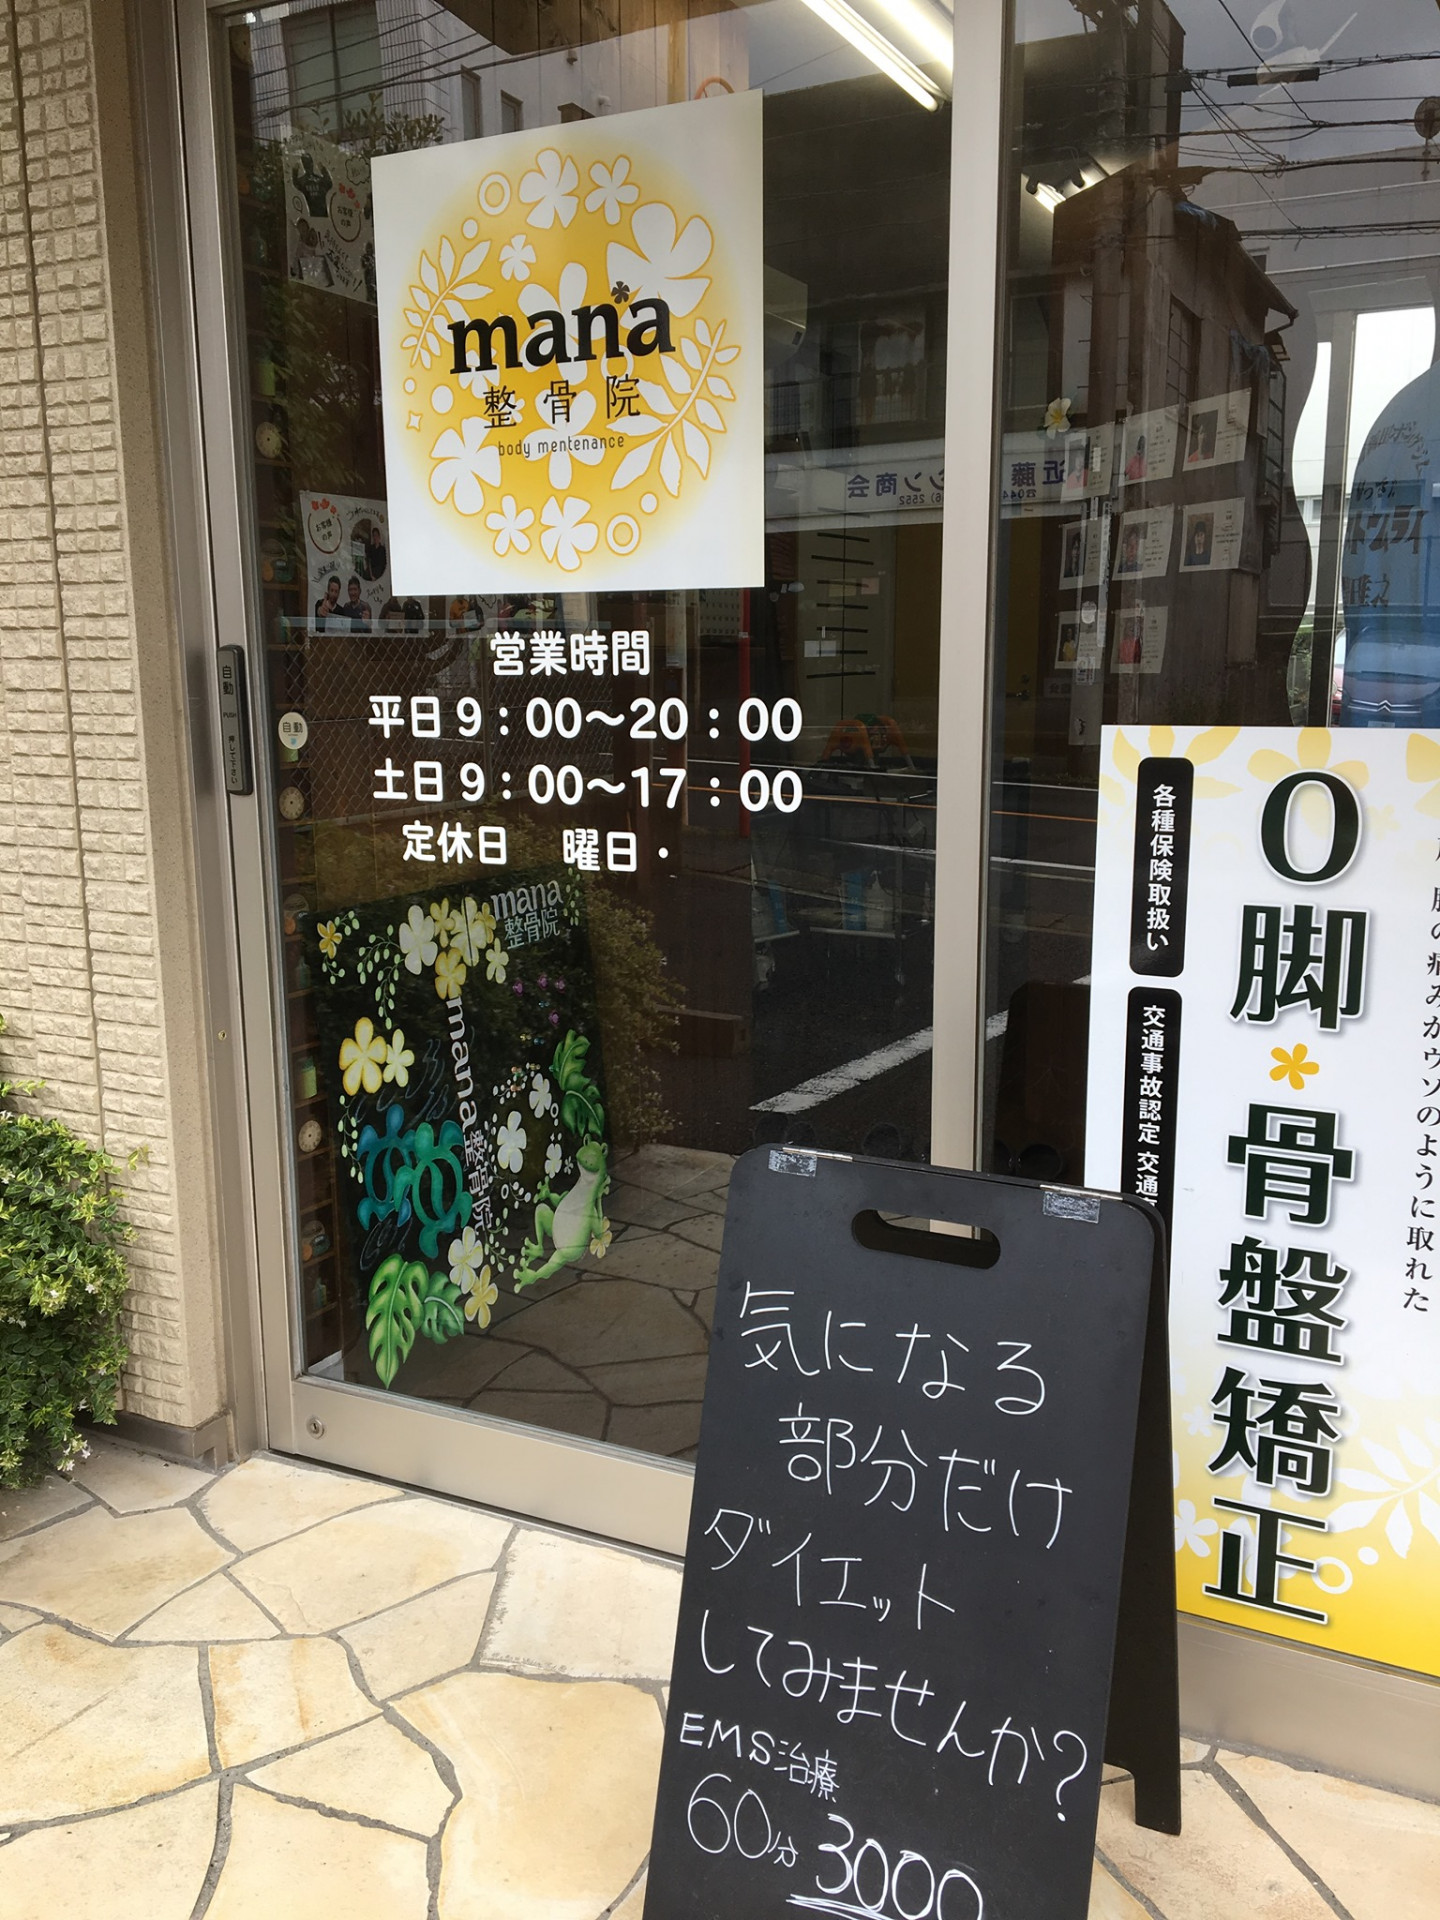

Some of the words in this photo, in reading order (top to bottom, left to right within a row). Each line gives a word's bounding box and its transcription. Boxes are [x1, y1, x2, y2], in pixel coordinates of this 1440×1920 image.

[447, 297, 676, 374] mana
[482, 373, 642, 429] 整骨院
[498, 441, 531, 458] body
[537, 435, 625, 454] mentenance
[222, 664, 234, 695] 自動
[490, 630, 650, 676] 営業時間
[222, 711, 237, 719] PUSH
[282, 721, 304, 733] 自動
[402, 820, 507, 865] 定休日
[1146, 783, 1177, 952] 各種保険取扱い
[490, 881, 563, 921] mana
[503, 906, 561, 950] 整骨院
[1137, 1004, 1166, 1146] 交通事故認定
[740, 1281, 1045, 1415] 気になる
[1204, 1102, 1355, 1623] 骨盤矯正
[778, 1402, 1073, 1549] 部分だけ
[703, 1508, 956, 1631] ダイエット
[686, 1773, 799, 1868] 60分
[815, 1813, 984, 1920] 3000
